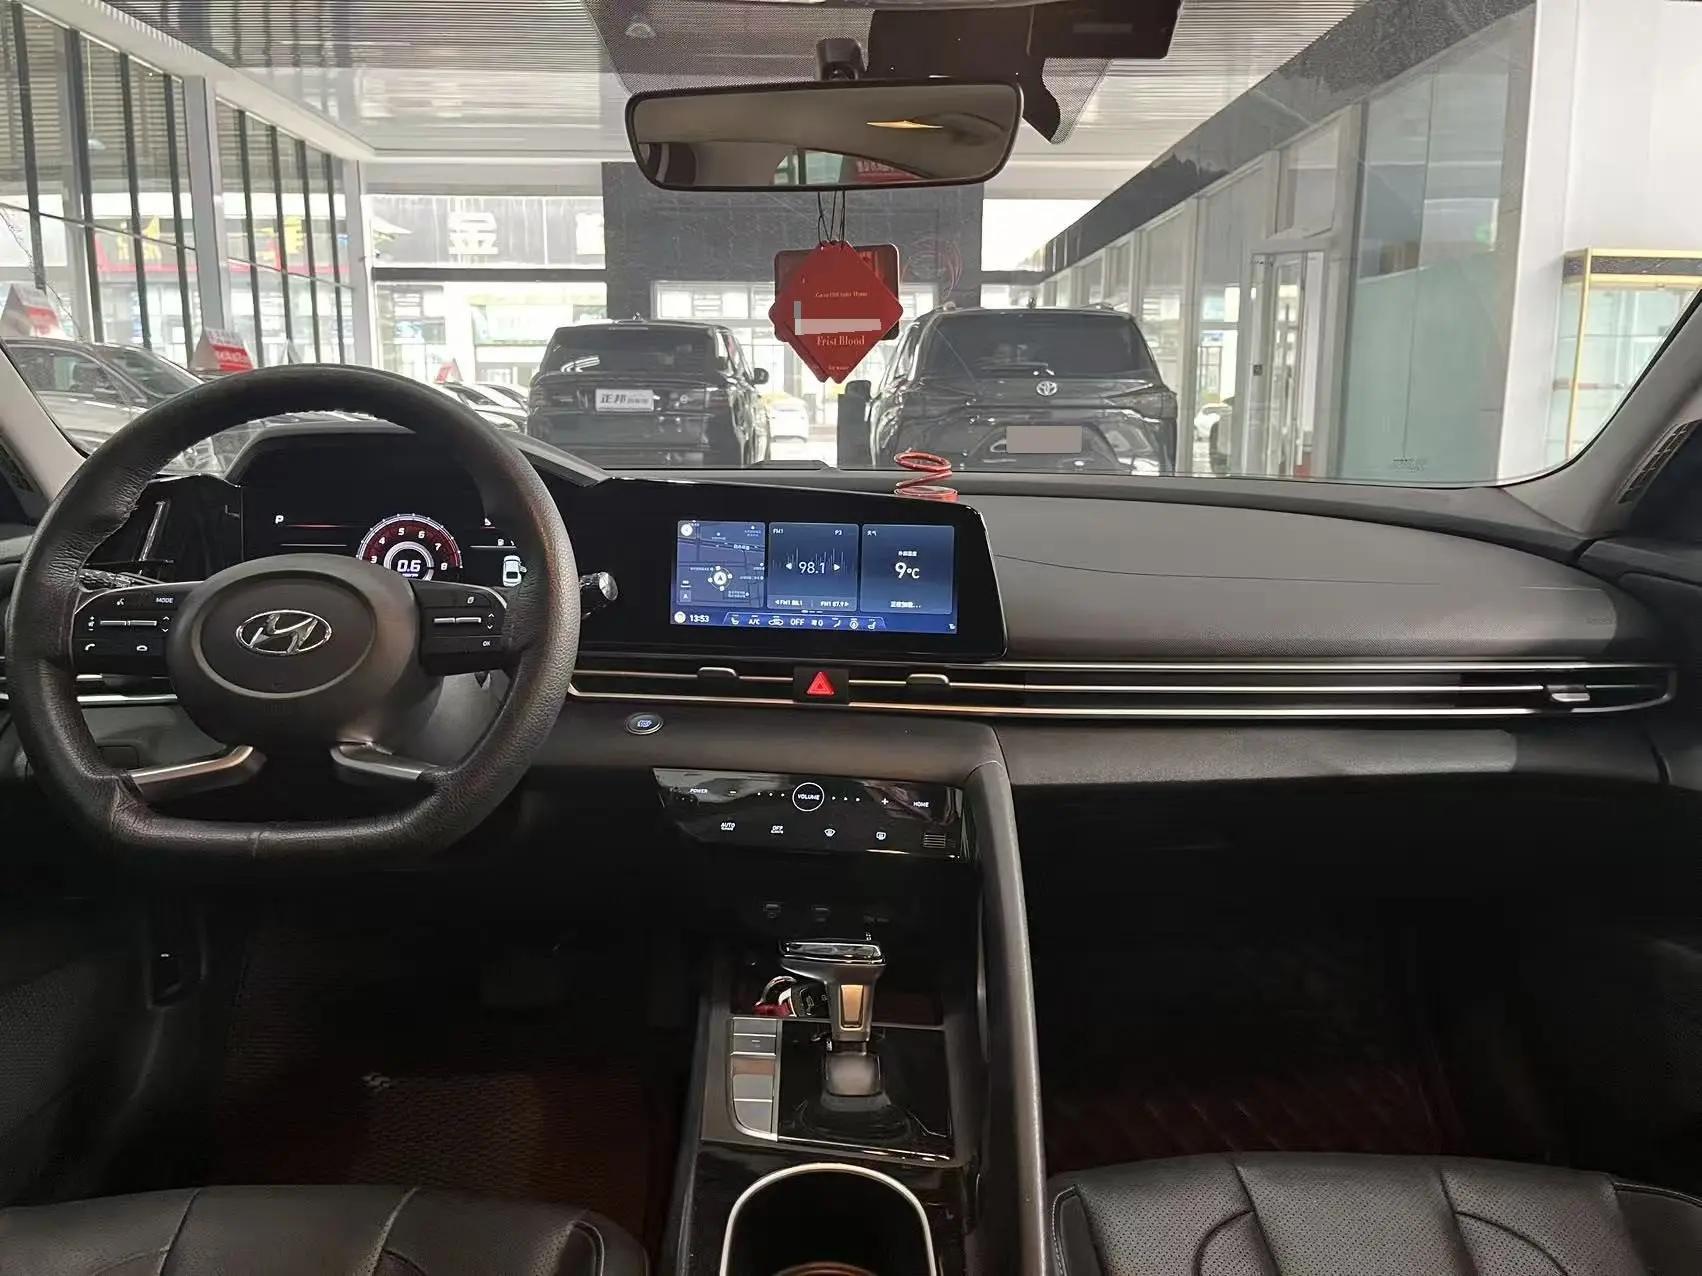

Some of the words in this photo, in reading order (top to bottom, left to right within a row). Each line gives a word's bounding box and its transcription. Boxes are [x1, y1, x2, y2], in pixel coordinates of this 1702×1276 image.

[839, 335, 865, 346] Blood
[398, 527, 406, 536] 5
[418, 530, 426, 539] 6
[378, 536, 386, 545] 4
[434, 542, 442, 551] 7
[370, 555, 378, 564] 3
[396, 559, 422, 573] 0.6
[440, 562, 448, 571] 8
[798, 561, 825, 574] 98.1
[689, 614, 710, 623] 13:53
[748, 617, 760, 625] A/C
[790, 618, 805, 626] OFF
[797, 793, 821, 801] VOLUME
